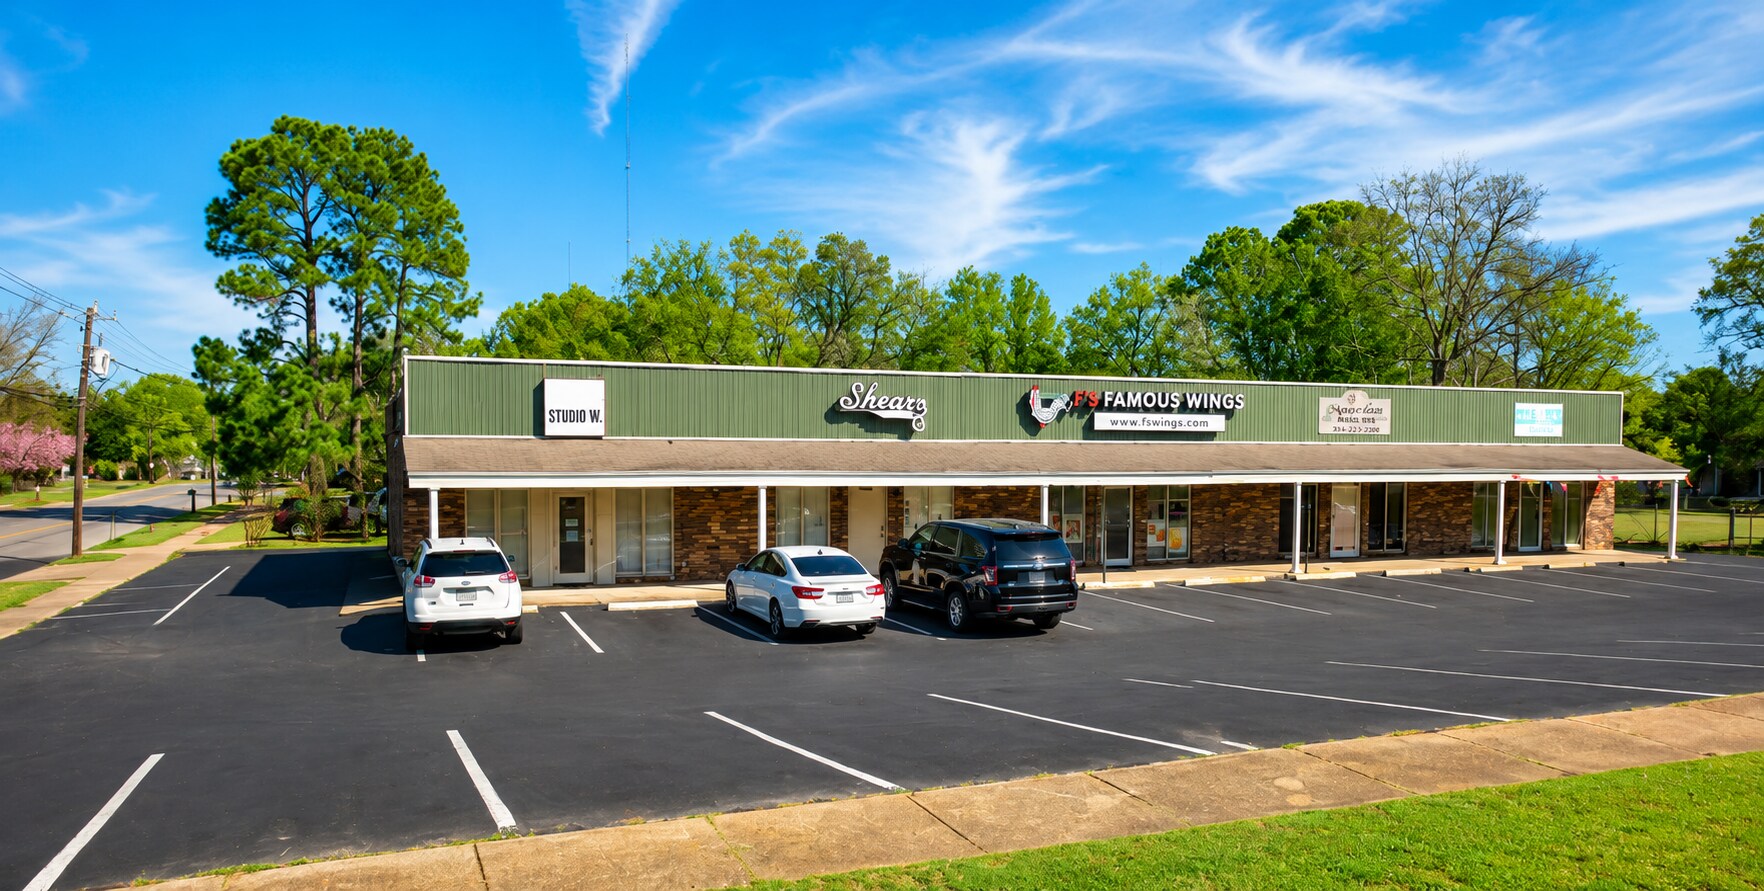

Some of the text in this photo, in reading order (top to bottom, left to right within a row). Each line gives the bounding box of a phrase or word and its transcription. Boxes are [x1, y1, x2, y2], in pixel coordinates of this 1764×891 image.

[1073, 389, 1245, 410] F'S FAMOUS WINGS
[548, 408, 603, 423] STUDIO W.
[1109, 416, 1209, 430] www.fswings.com
